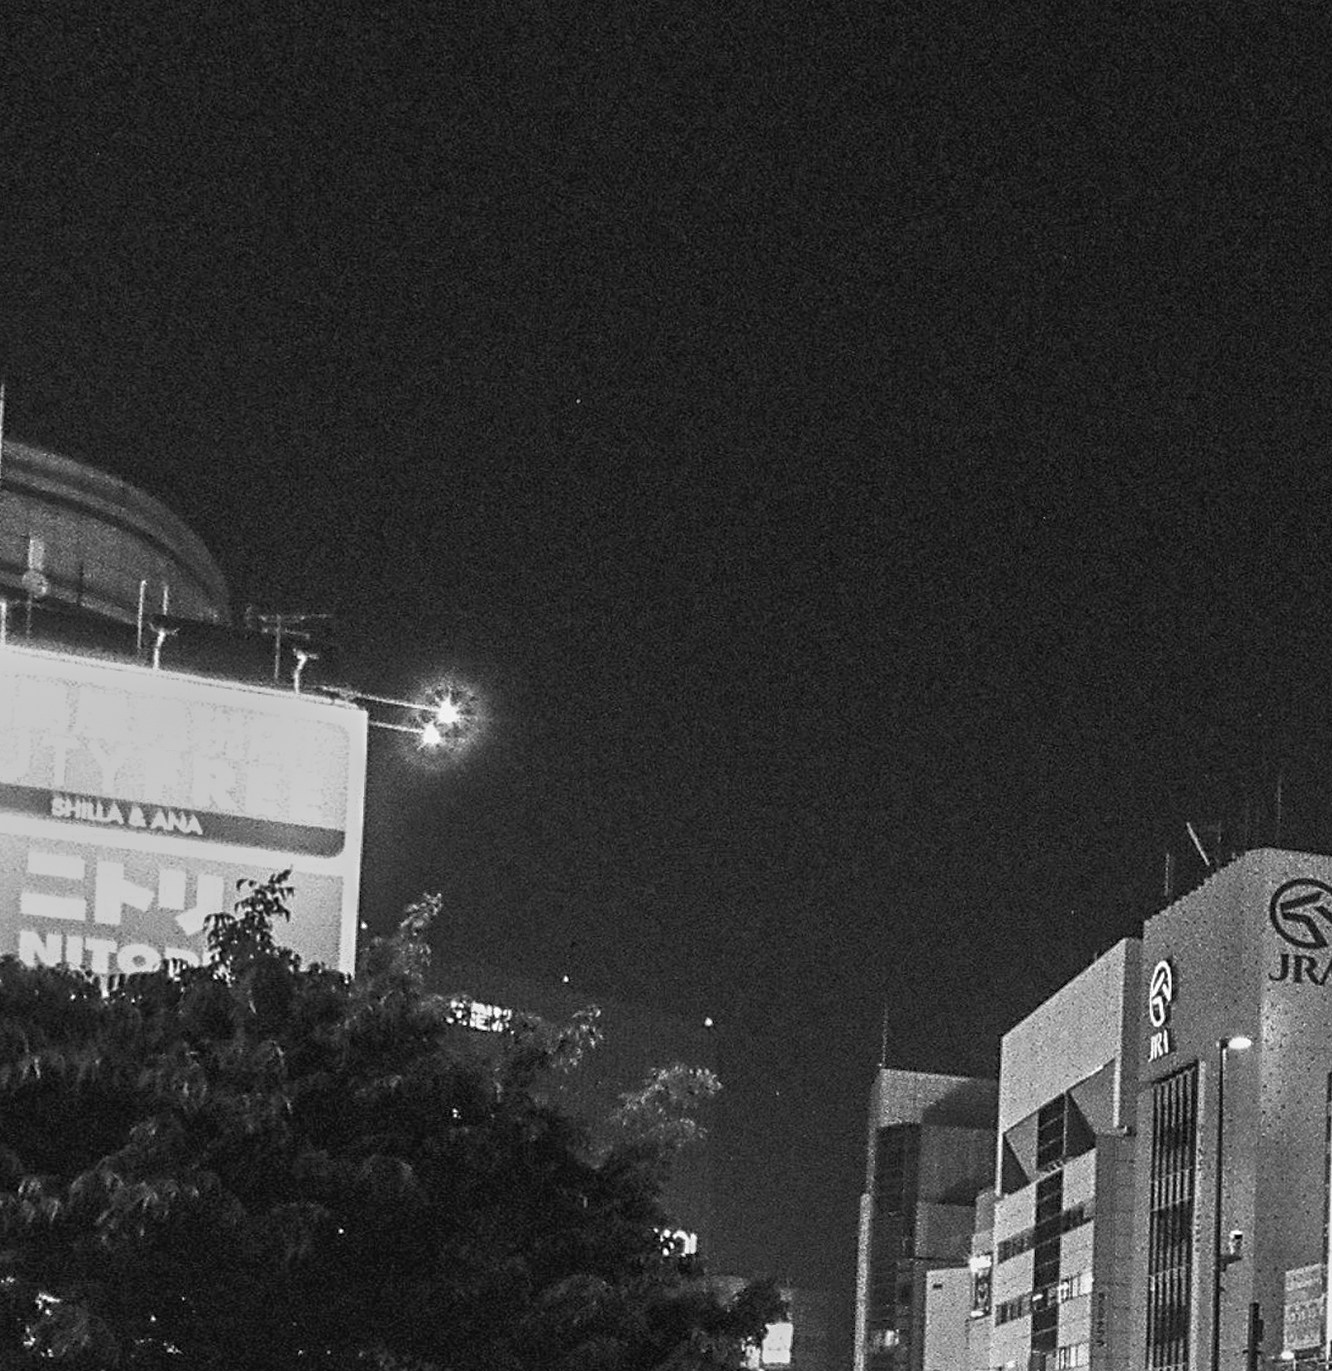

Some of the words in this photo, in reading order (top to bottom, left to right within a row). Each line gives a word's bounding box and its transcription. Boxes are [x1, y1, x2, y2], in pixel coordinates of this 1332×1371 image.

[52, 797, 122, 826] SHILLA
[129, 807, 146, 829] &
[151, 811, 203, 836] ANA
[20, 851, 225, 937] ニトリ
